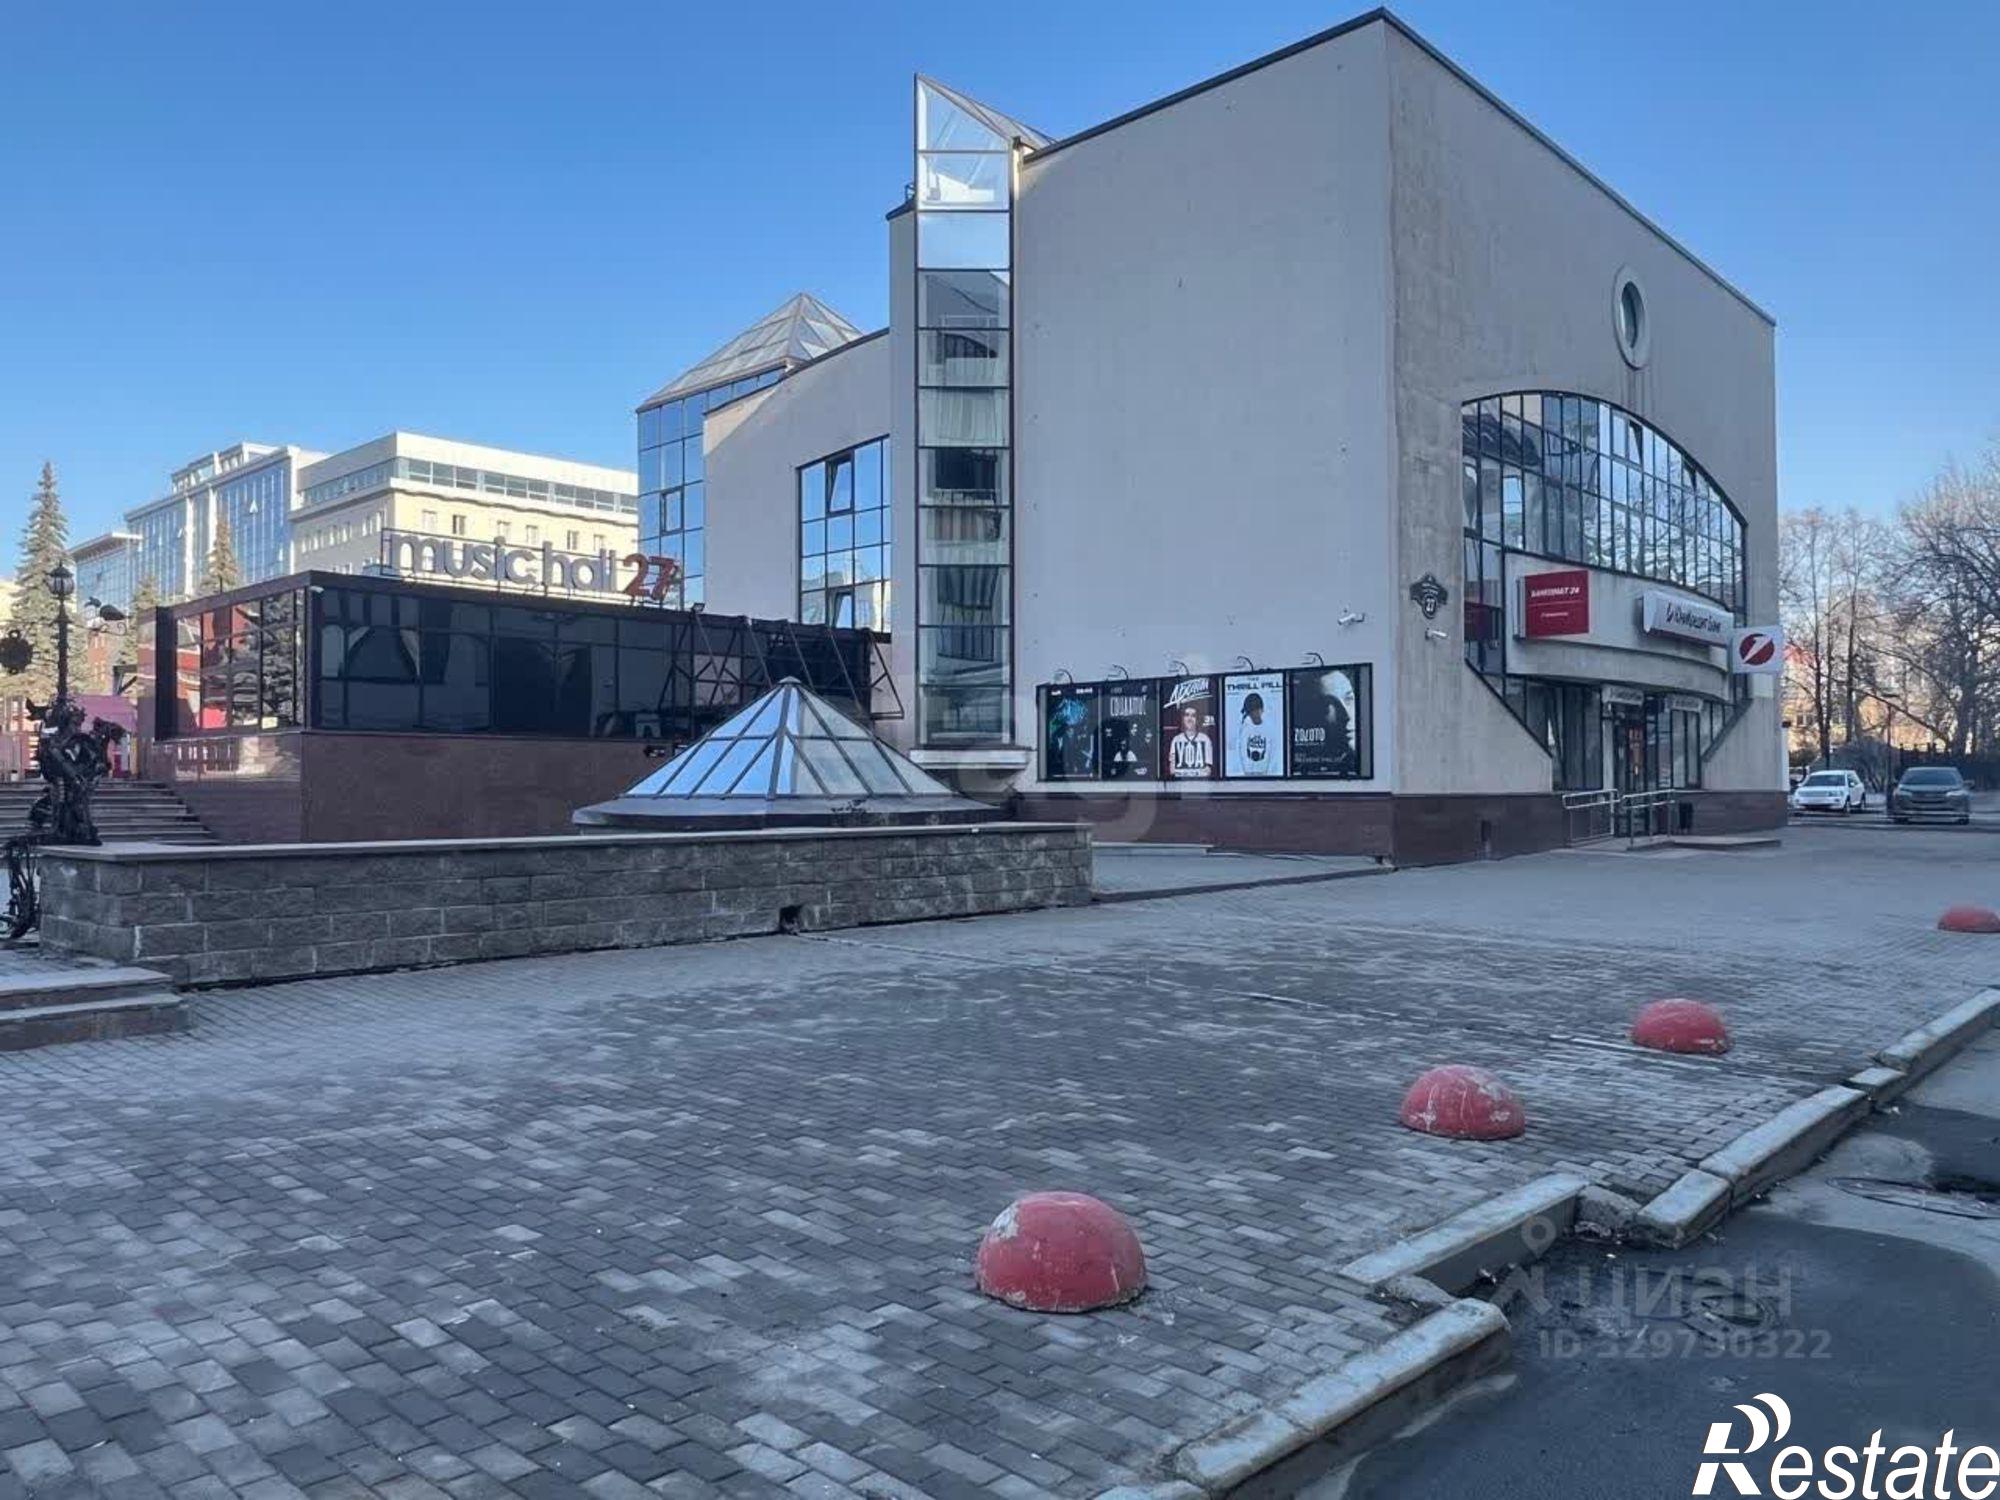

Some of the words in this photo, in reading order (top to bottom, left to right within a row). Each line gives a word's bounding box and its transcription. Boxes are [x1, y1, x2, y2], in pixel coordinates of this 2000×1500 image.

[391, 536, 537, 585] music
[542, 541, 615, 592] hall
[622, 553, 679, 600] 27
[1176, 740, 1204, 768] УФА
